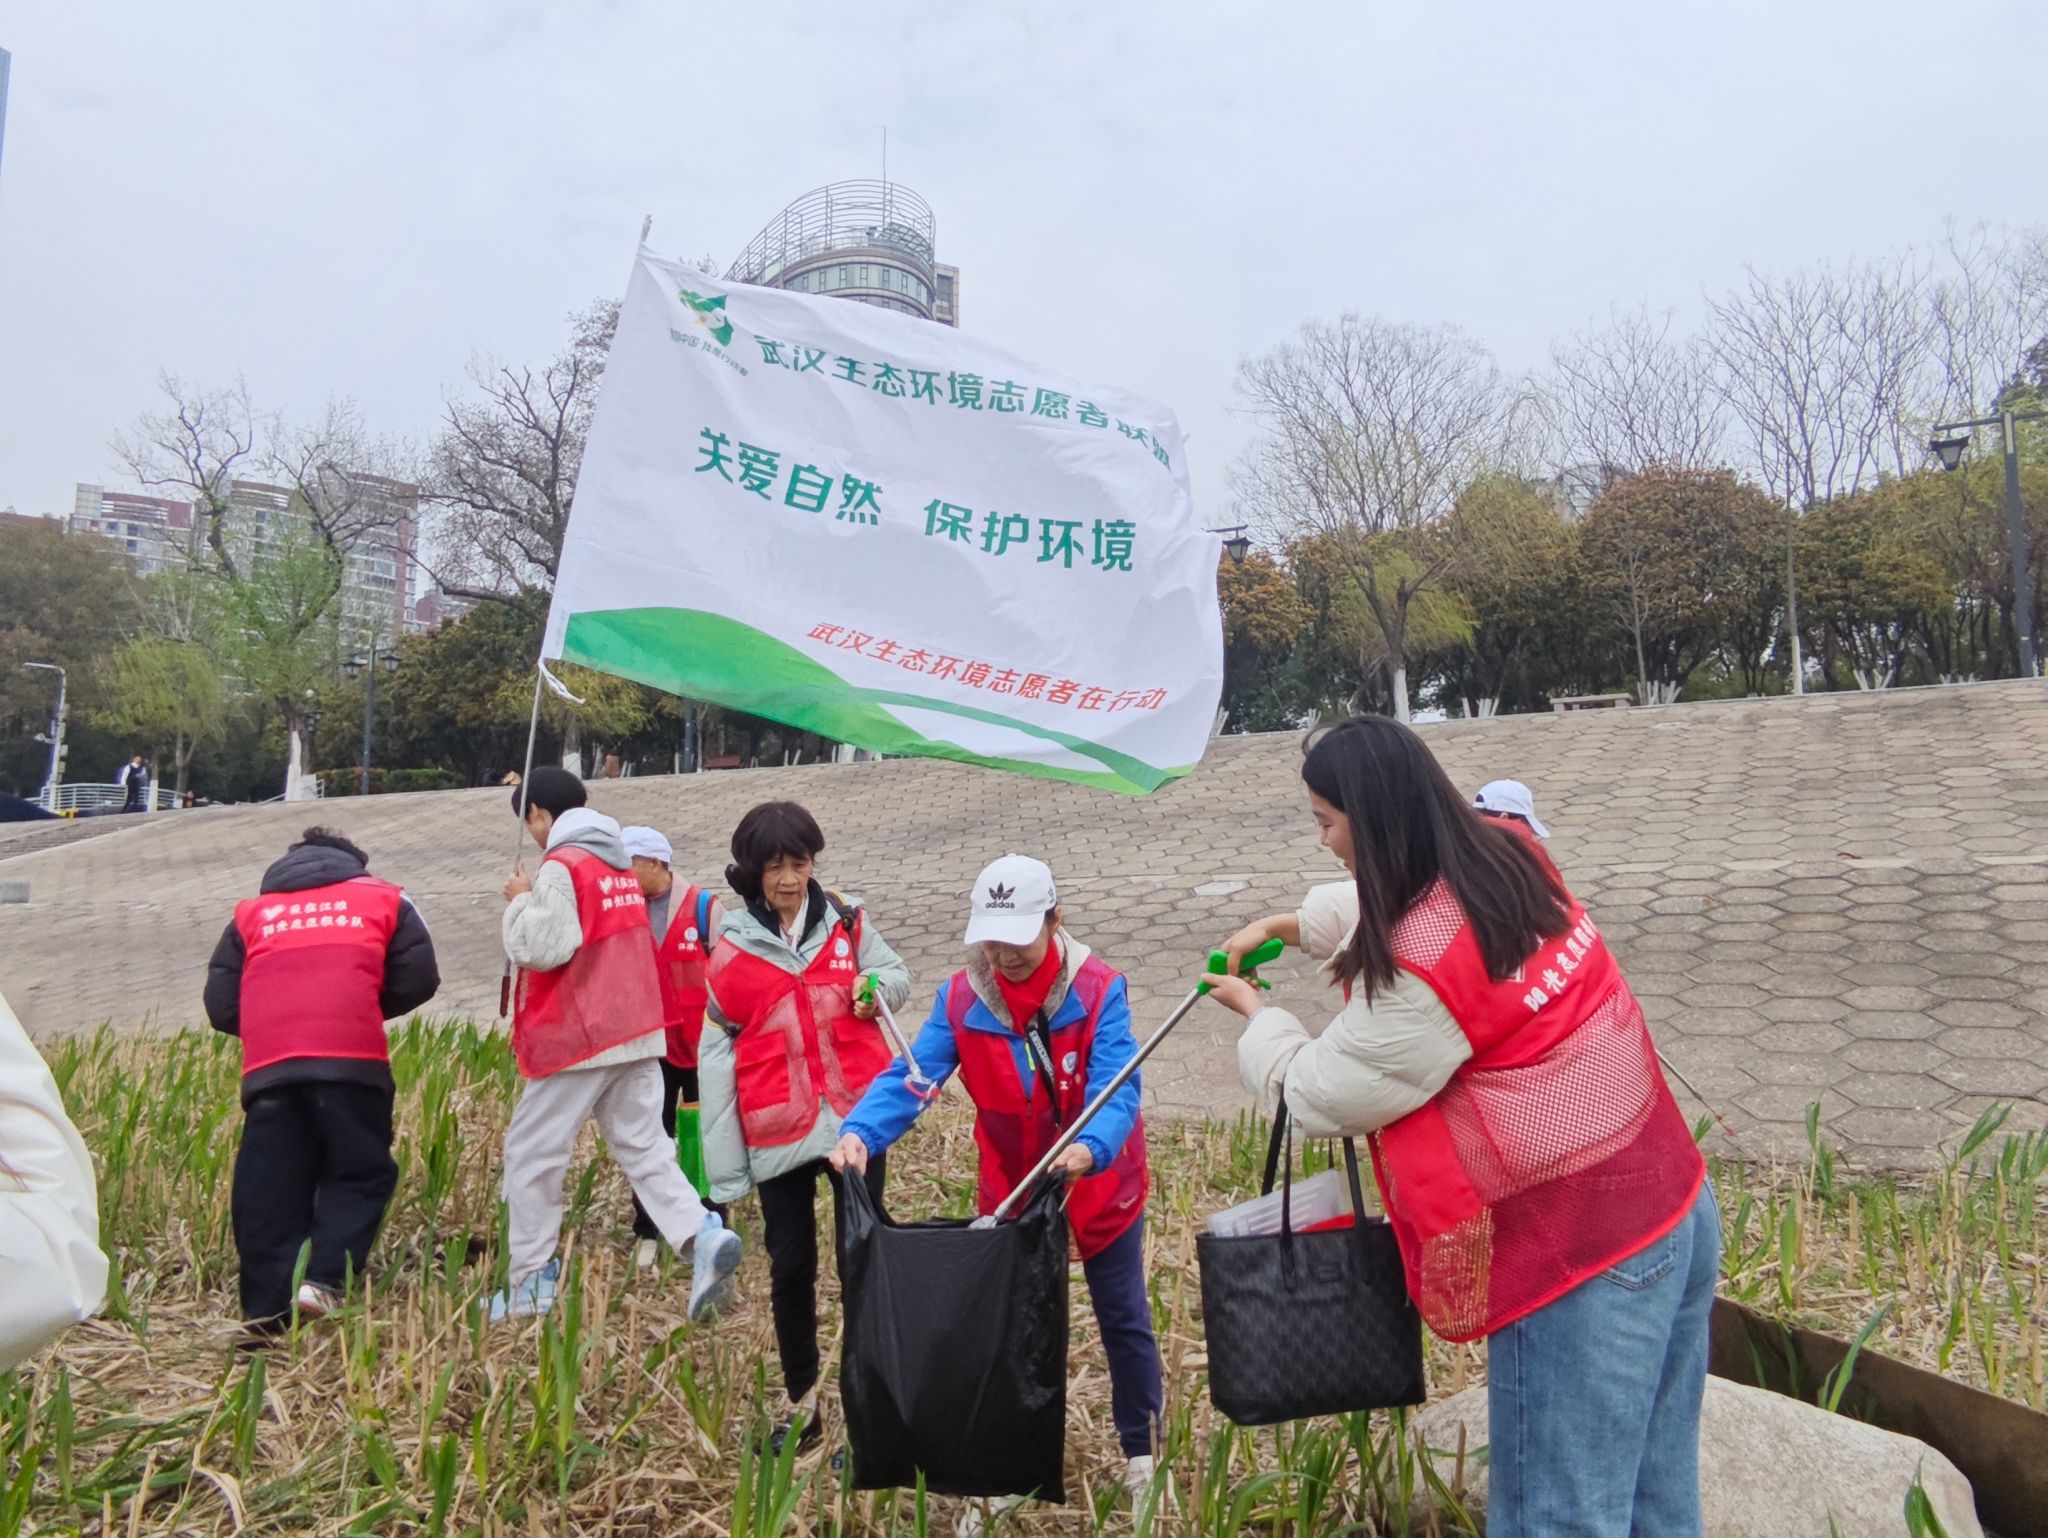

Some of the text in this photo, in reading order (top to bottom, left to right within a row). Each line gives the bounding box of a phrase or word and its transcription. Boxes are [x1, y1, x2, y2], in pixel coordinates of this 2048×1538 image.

[695, 426, 1137, 572] 关爱自然 保护环境
[806, 621, 1169, 713] 武汉生态环境志愿者在行动
[985, 900, 1016, 910] adidas
